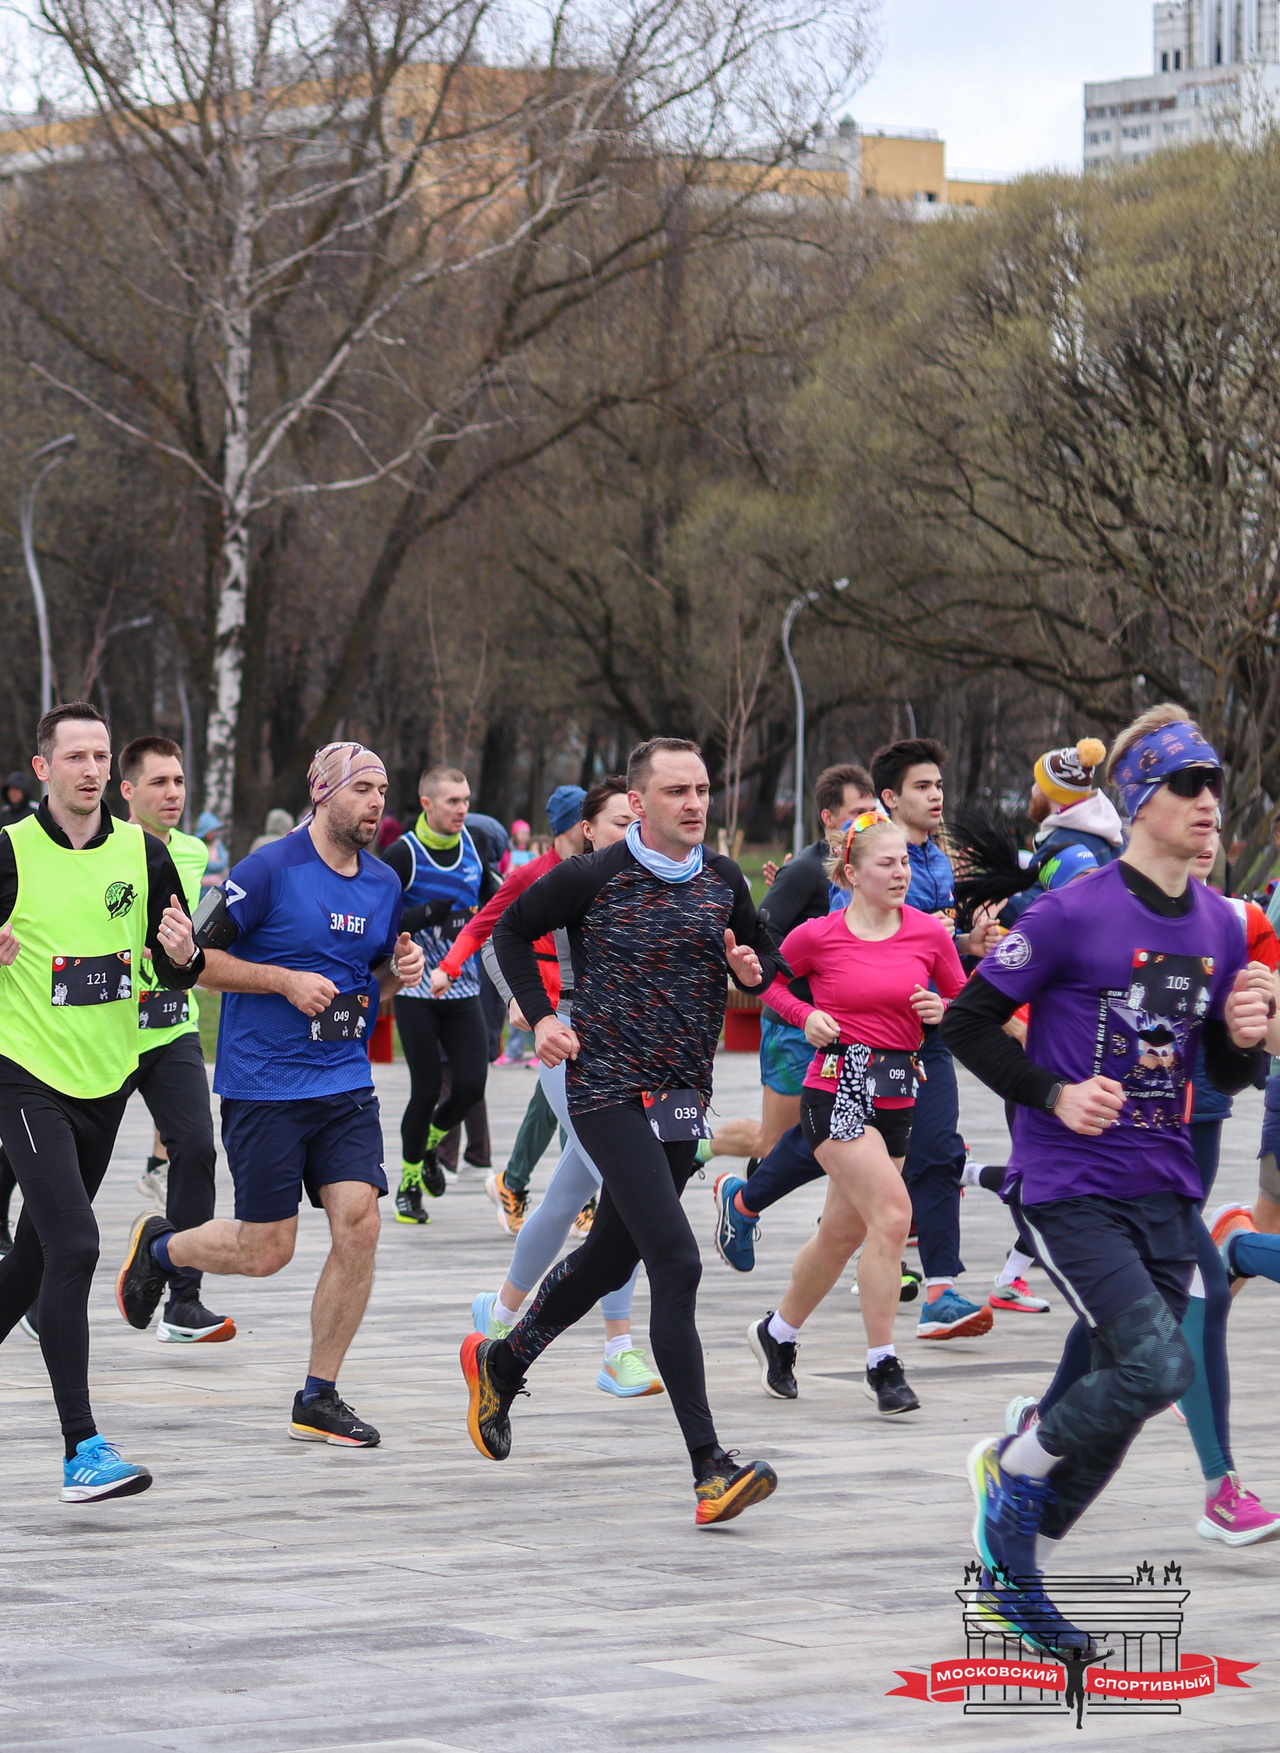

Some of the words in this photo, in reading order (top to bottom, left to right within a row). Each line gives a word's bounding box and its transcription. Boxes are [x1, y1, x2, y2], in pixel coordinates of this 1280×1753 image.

[86, 972, 107, 985] 121
[1166, 975, 1191, 990] 105
[163, 1002, 177, 1013] 119
[333, 1011, 350, 1022] 049
[889, 1068, 906, 1080] 099
[674, 1106, 697, 1120] 039
